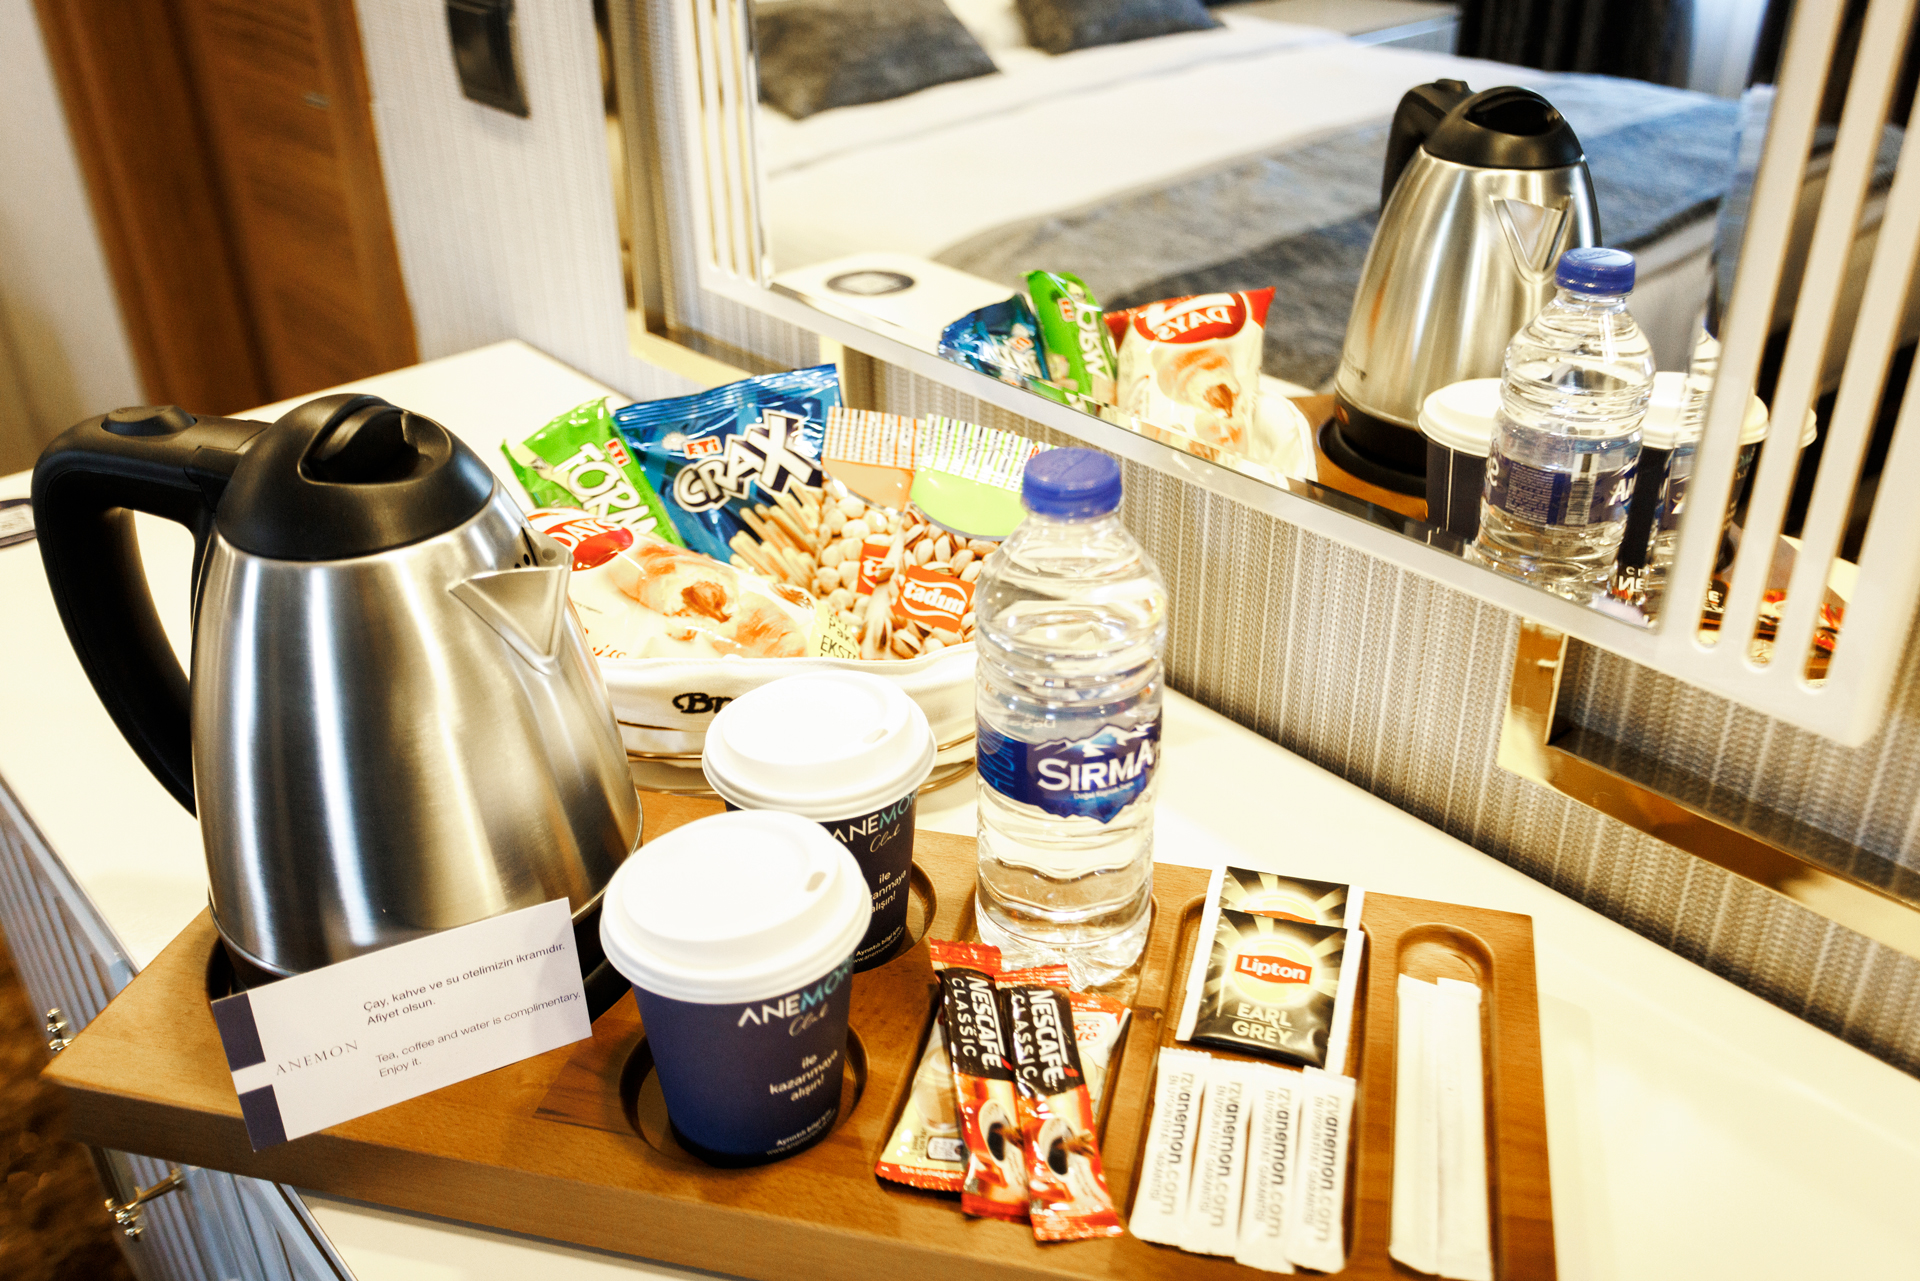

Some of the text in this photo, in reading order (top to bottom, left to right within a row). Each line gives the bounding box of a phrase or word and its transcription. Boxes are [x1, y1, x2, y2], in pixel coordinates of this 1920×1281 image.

[675, 411, 816, 507] CRAX
[1037, 739, 1154, 791] SIRMA
[879, 872, 891, 884] ile
[1240, 957, 1306, 980] Lipton
[363, 998, 389, 1012] Çay,
[392, 986, 426, 1002] kahve
[429, 981, 443, 991] ve
[446, 976, 460, 986] su
[462, 958, 514, 980] otelimizin
[367, 999, 436, 1026] Afiyet olsun.
[951, 977, 977, 1057] CLASSIC
[1237, 1002, 1292, 1029] EARL
[375, 991, 581, 1064] Tea, coffee and water is complimentary.
[1231, 1020, 1293, 1045] GREY
[276, 1040, 358, 1075] ANEMON
[379, 1058, 422, 1078] Enjoy it.
[802, 1054, 817, 1069] ile
